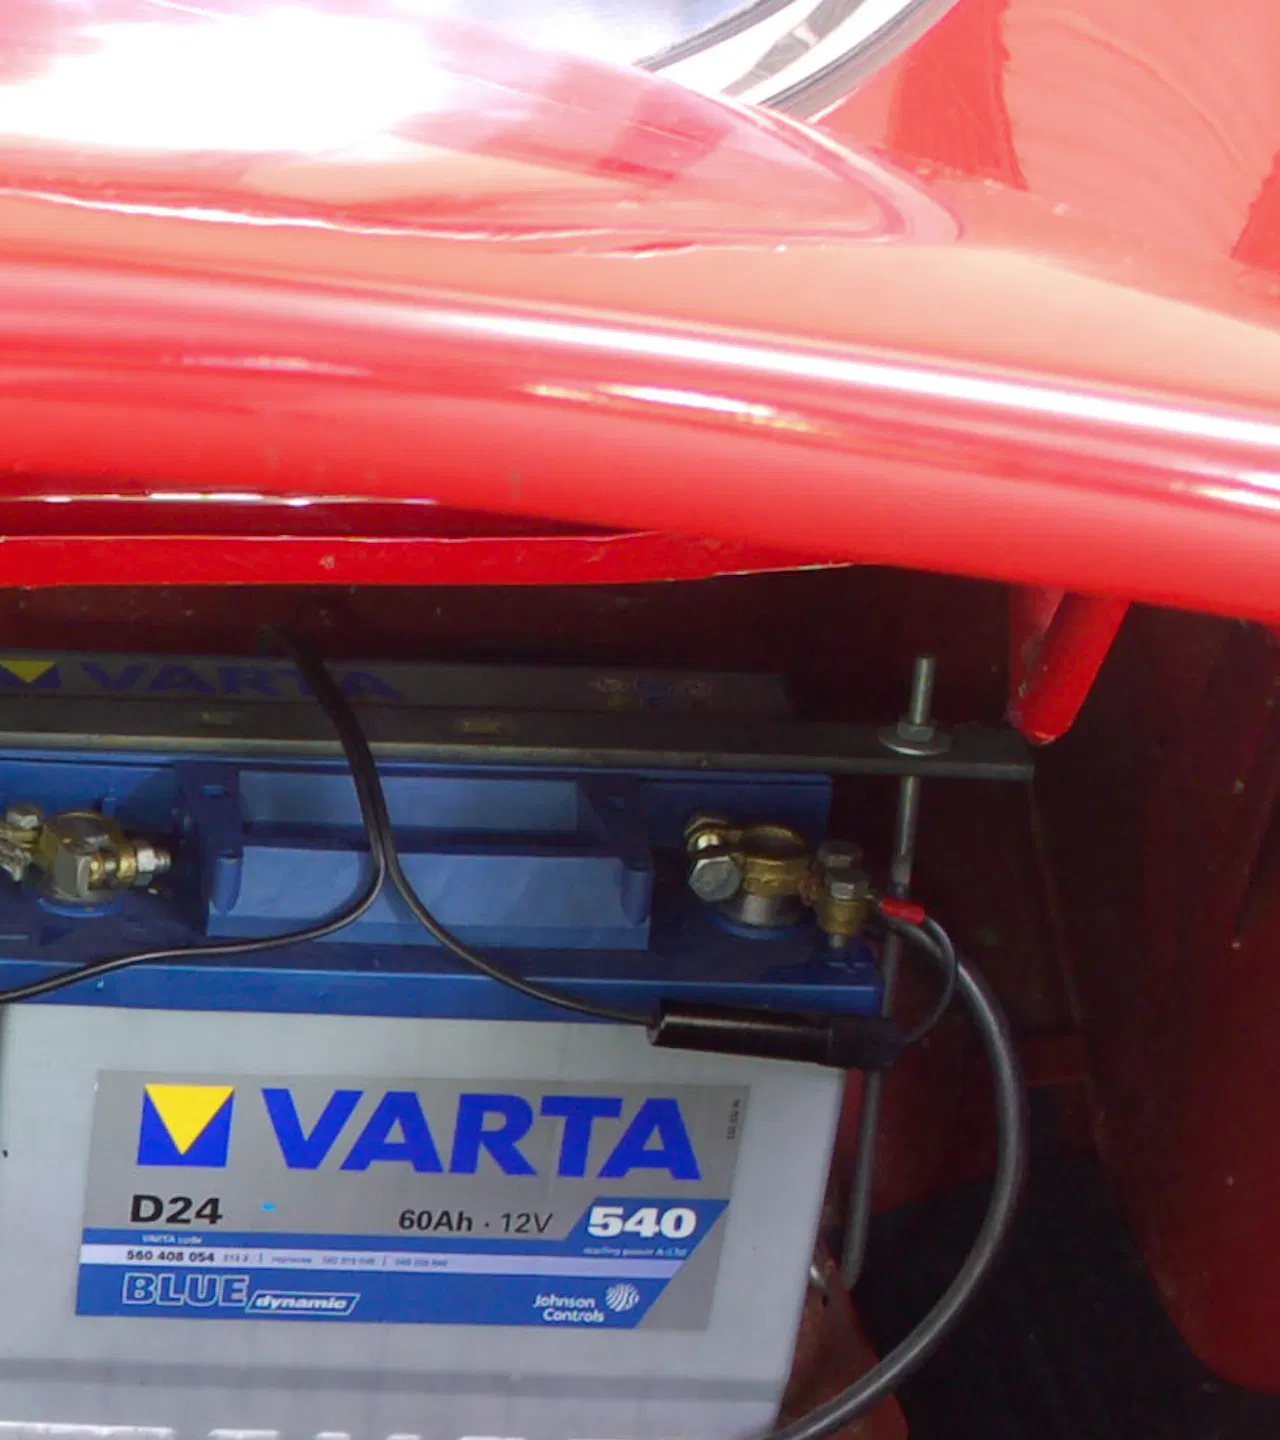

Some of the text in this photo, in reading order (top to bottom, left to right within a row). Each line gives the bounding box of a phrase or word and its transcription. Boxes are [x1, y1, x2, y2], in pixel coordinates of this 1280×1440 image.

[261, 1087, 703, 1181] VARTA
[130, 1194, 223, 1225] D24
[398, 1209, 553, 1234] 60Ah 12V
[587, 1206, 697, 1239] 540
[126, 1250, 153, 1261] 560
[156, 1251, 184, 1262] 408
[189, 1252, 215, 1263] 054
[122, 1272, 250, 1307] BLUE
[254, 1293, 348, 1311] dynamic
[533, 1294, 596, 1309] Johnson
[543, 1309, 605, 1323] Controls
